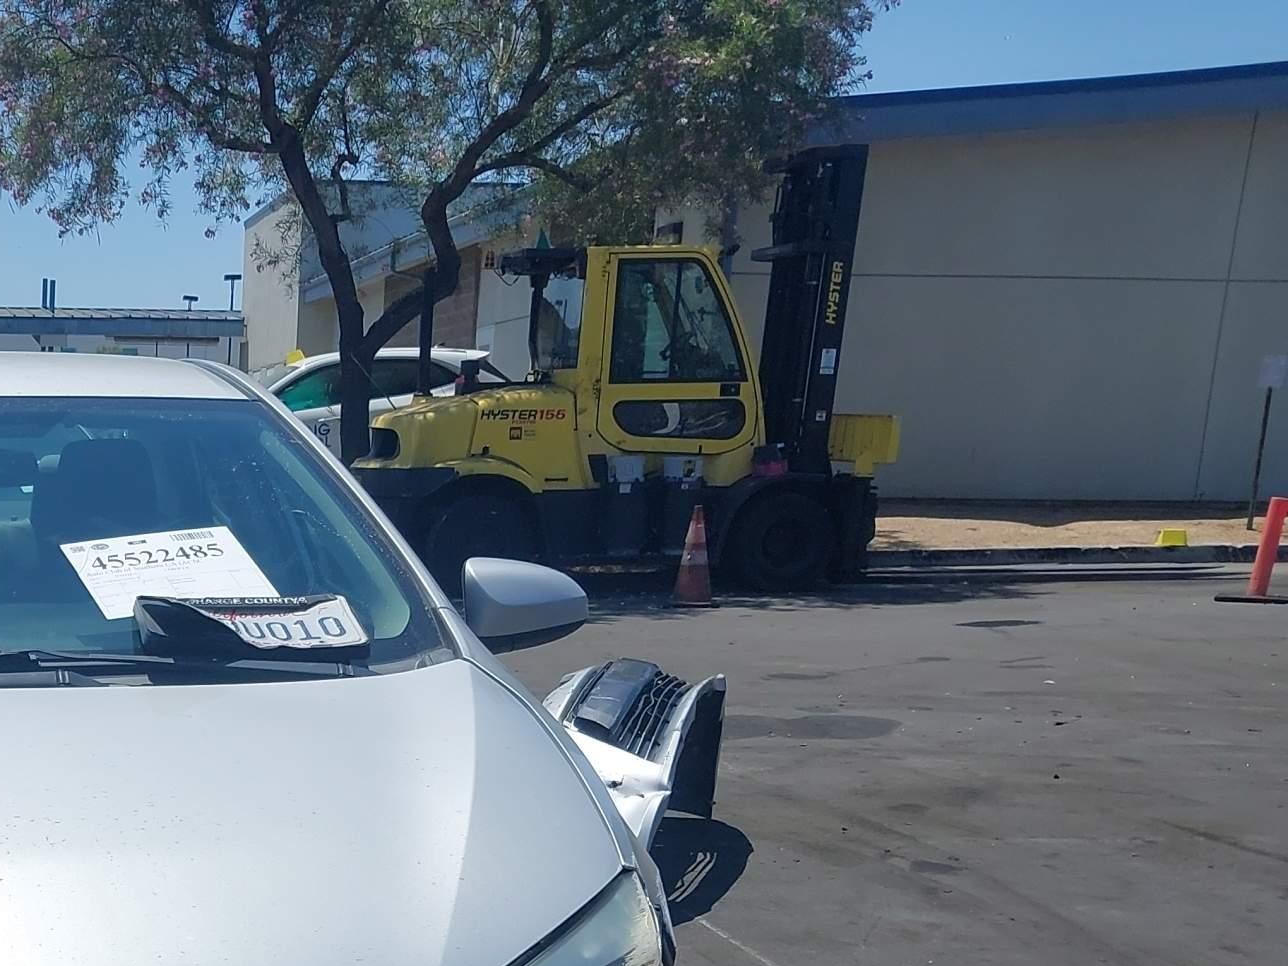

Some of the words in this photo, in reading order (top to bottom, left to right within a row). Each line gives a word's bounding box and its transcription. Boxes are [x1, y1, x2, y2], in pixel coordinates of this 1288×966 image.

[825, 261, 844, 324] HYSTER
[480, 409, 538, 421] HYSTER
[91, 543, 224, 570] 45522485
